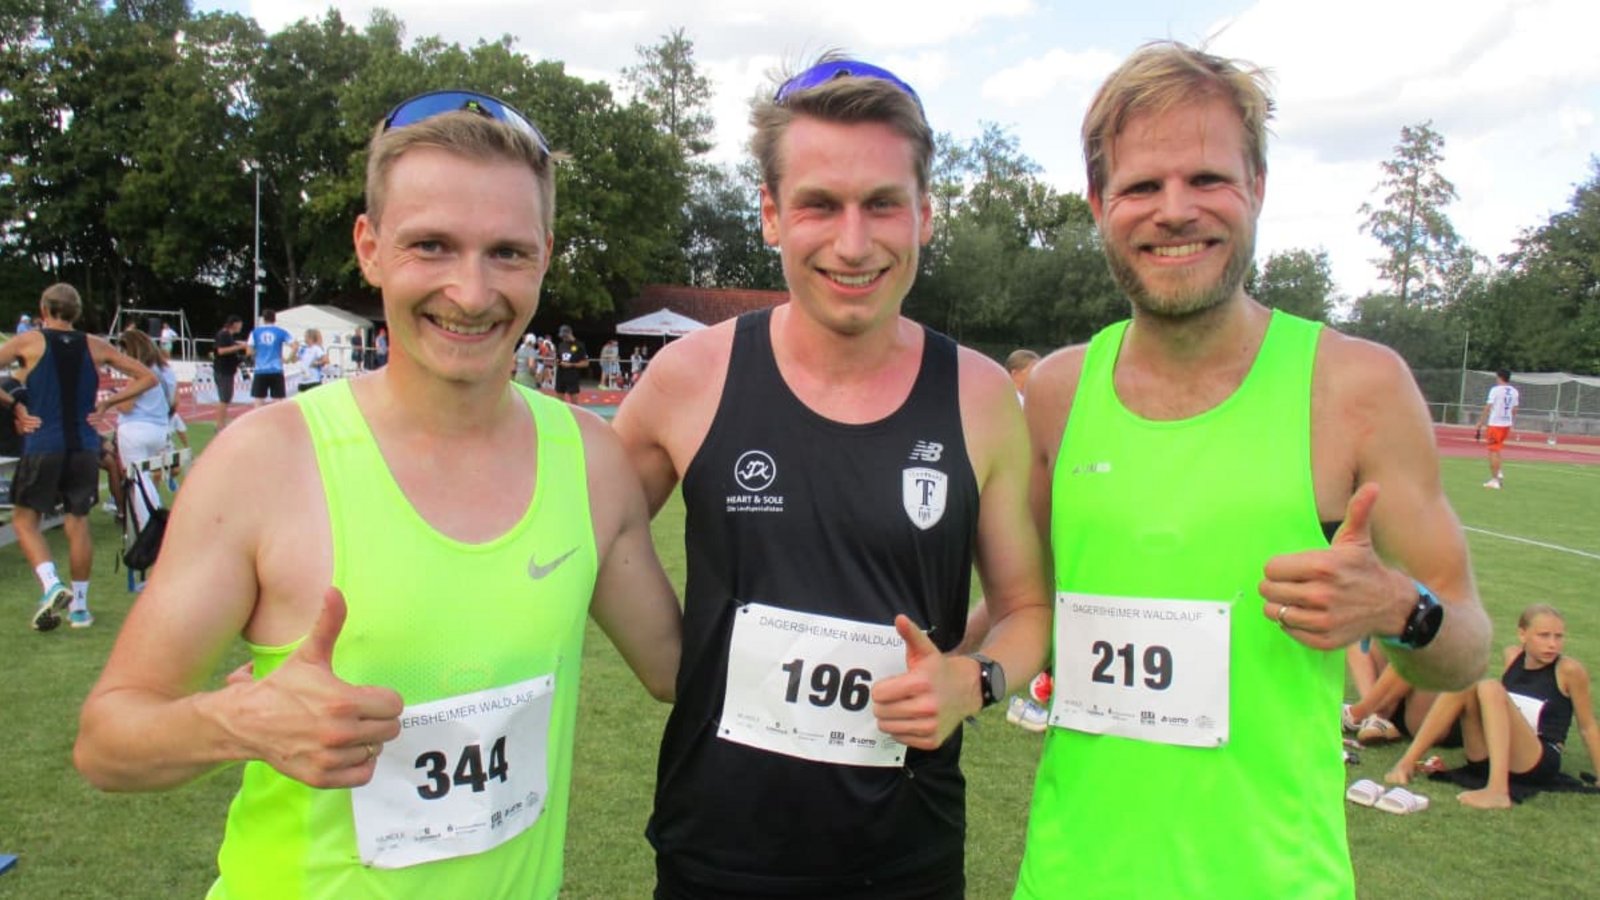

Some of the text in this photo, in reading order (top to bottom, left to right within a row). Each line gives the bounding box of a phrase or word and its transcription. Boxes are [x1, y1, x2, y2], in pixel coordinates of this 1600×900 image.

[726, 495, 783, 504] HEART & SOLE
[759, 615, 848, 640] DAGERSHEIMER
[1142, 609, 1203, 622] WALDLAUF
[782, 658, 872, 712] 196
[1091, 640, 1173, 691] 219
[401, 690, 535, 729] ERSHEIMER WALDLAUF
[414, 735, 509, 800] 344
